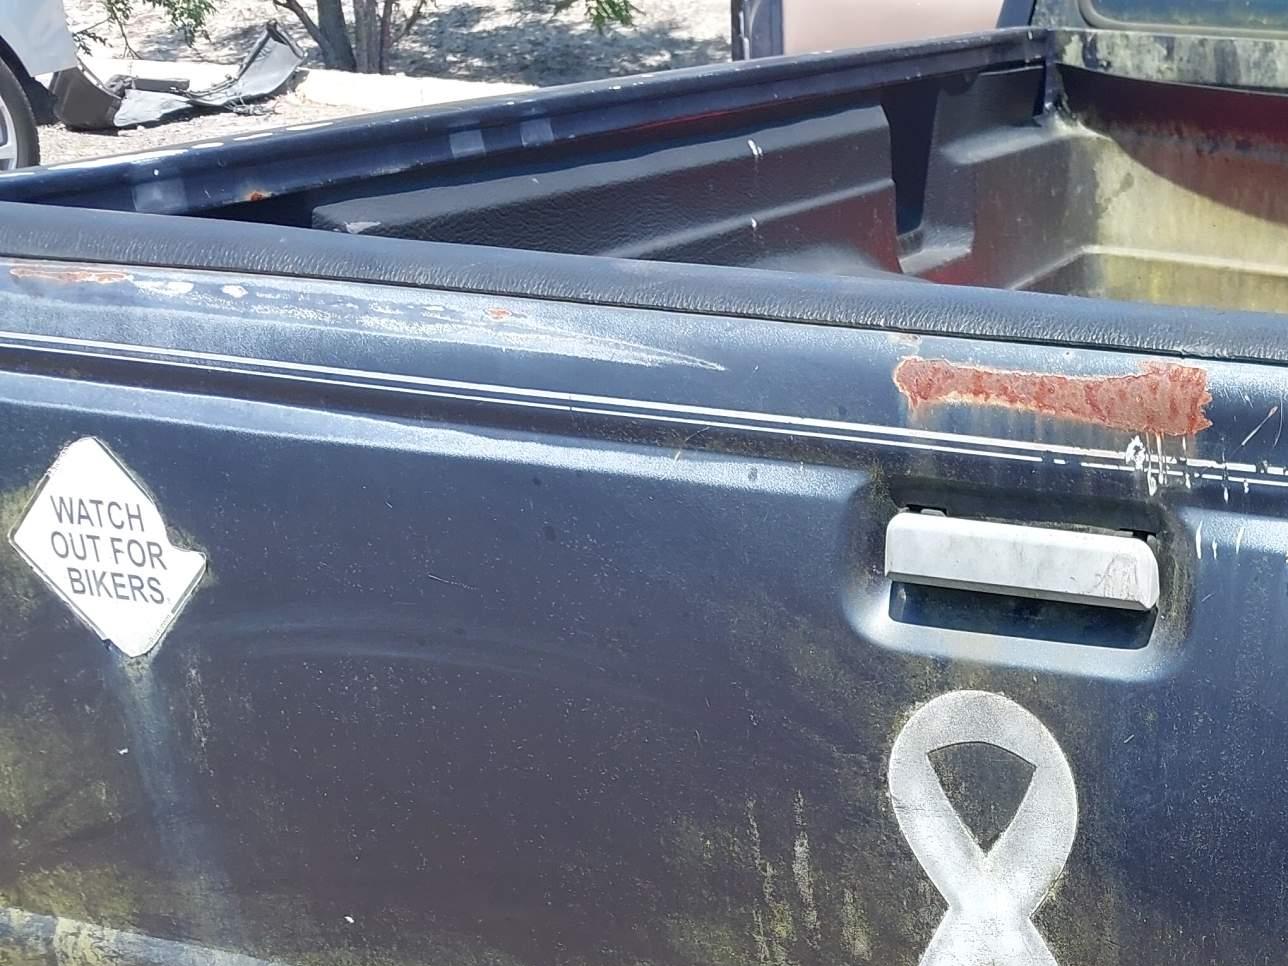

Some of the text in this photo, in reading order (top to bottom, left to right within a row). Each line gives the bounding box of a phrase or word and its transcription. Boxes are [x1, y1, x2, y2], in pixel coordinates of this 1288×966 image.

[50, 495, 145, 532] WATCH
[50, 531, 168, 571] OUT FOR
[66, 566, 165, 605] BIKERS
